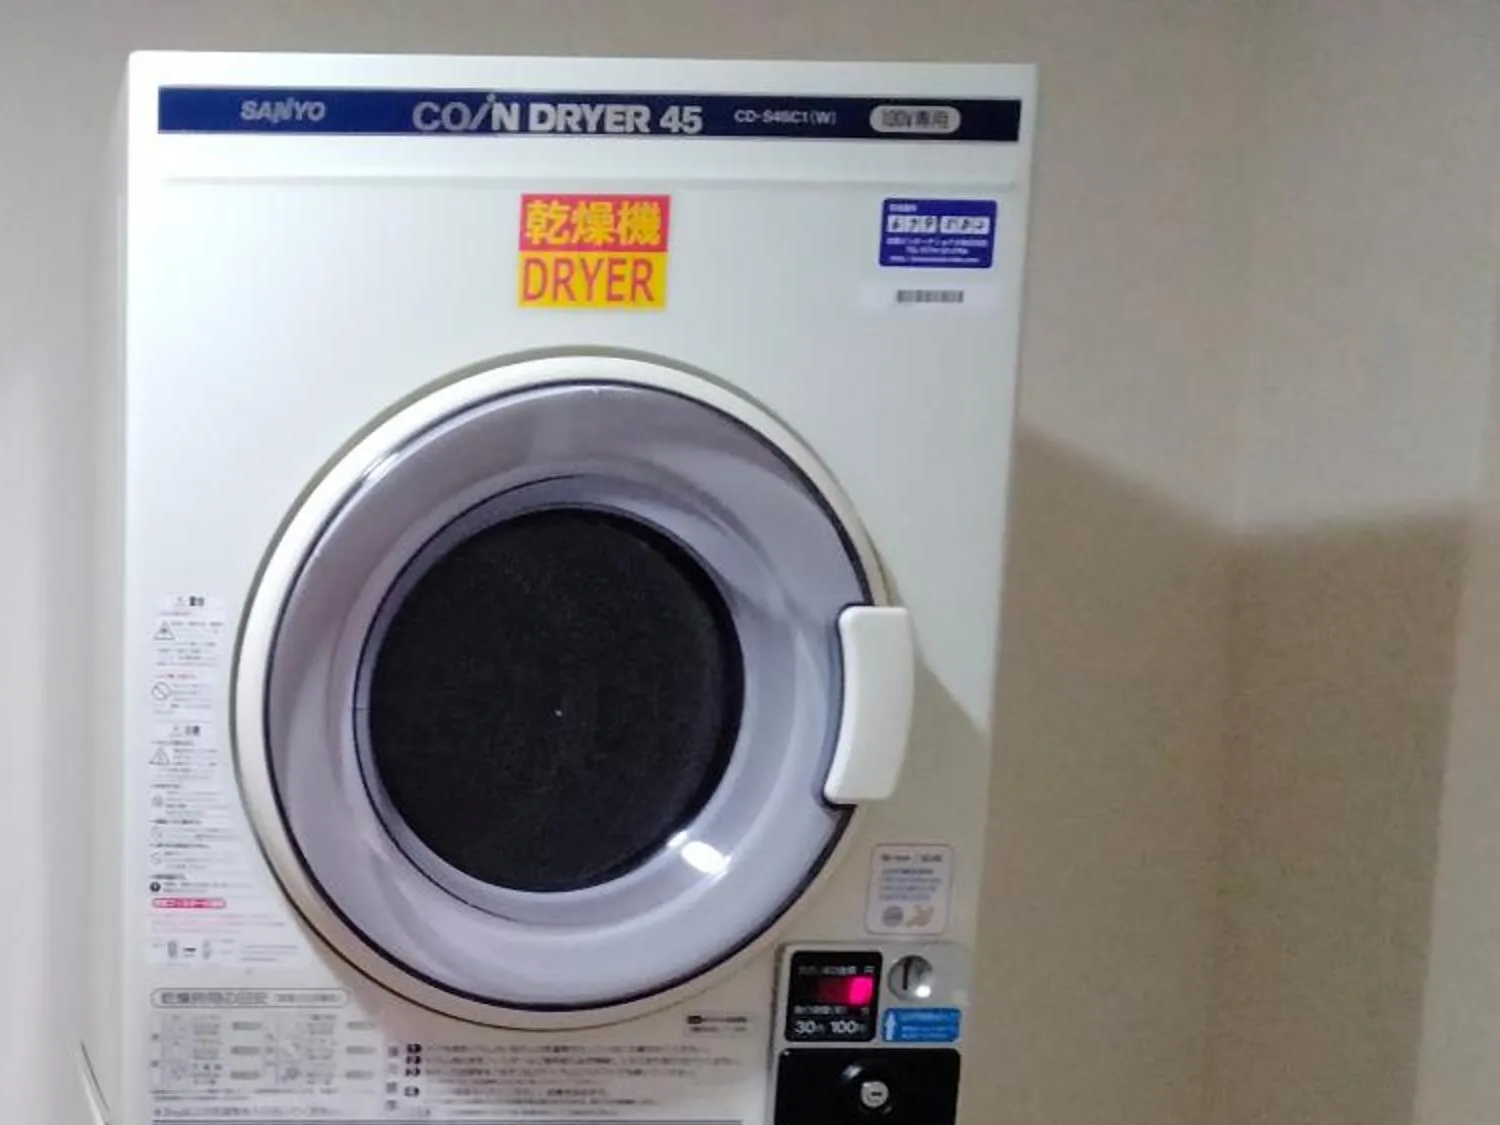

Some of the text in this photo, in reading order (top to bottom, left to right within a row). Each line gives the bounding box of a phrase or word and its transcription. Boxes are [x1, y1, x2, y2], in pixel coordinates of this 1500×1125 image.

[240, 97, 327, 123] SANYO
[412, 94, 521, 133] COIN
[529, 103, 651, 133] DRYER
[659, 105, 703, 134] 45
[525, 200, 662, 245] 乾燥機
[522, 257, 656, 302] DRYER
